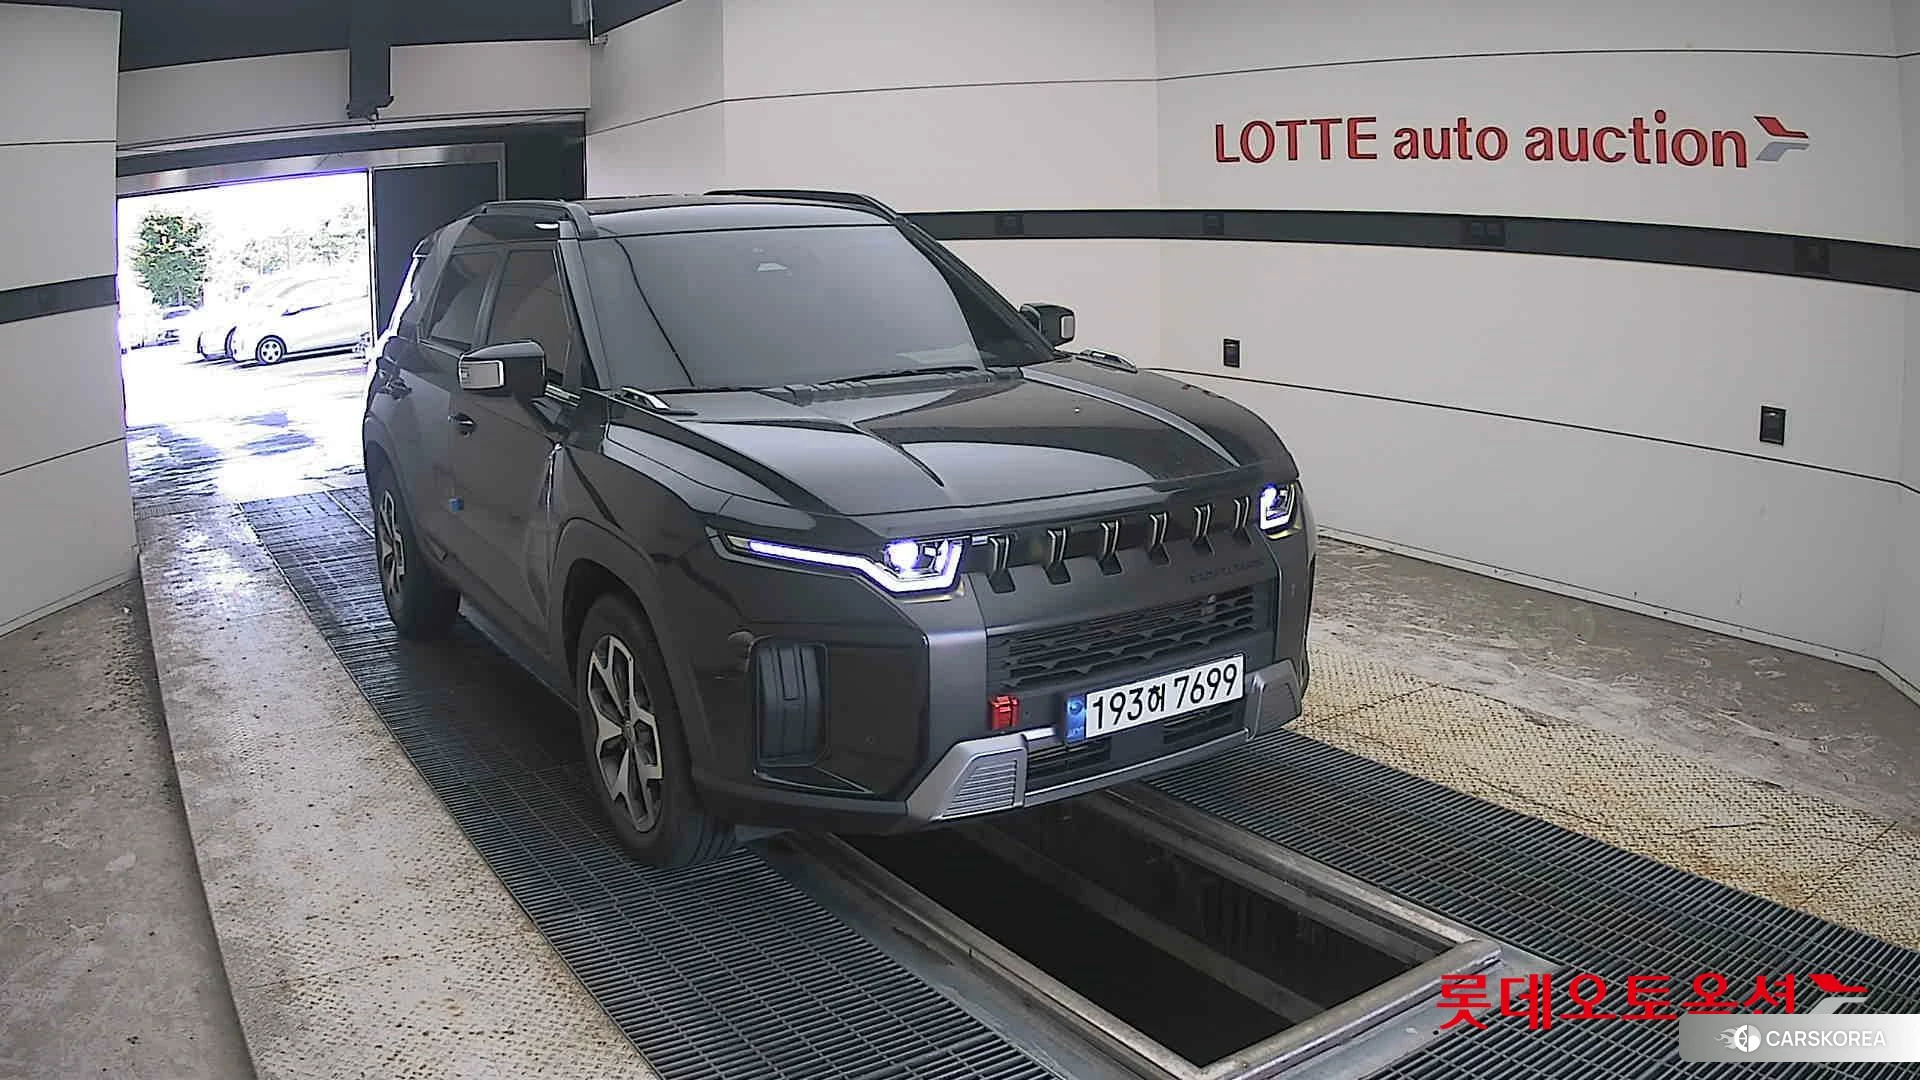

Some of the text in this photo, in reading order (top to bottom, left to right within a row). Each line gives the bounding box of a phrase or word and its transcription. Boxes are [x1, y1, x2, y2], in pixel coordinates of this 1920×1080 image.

[1215, 109, 1749, 169] LOTTE auto auction
[1092, 663, 1238, 730] 193허 7699
